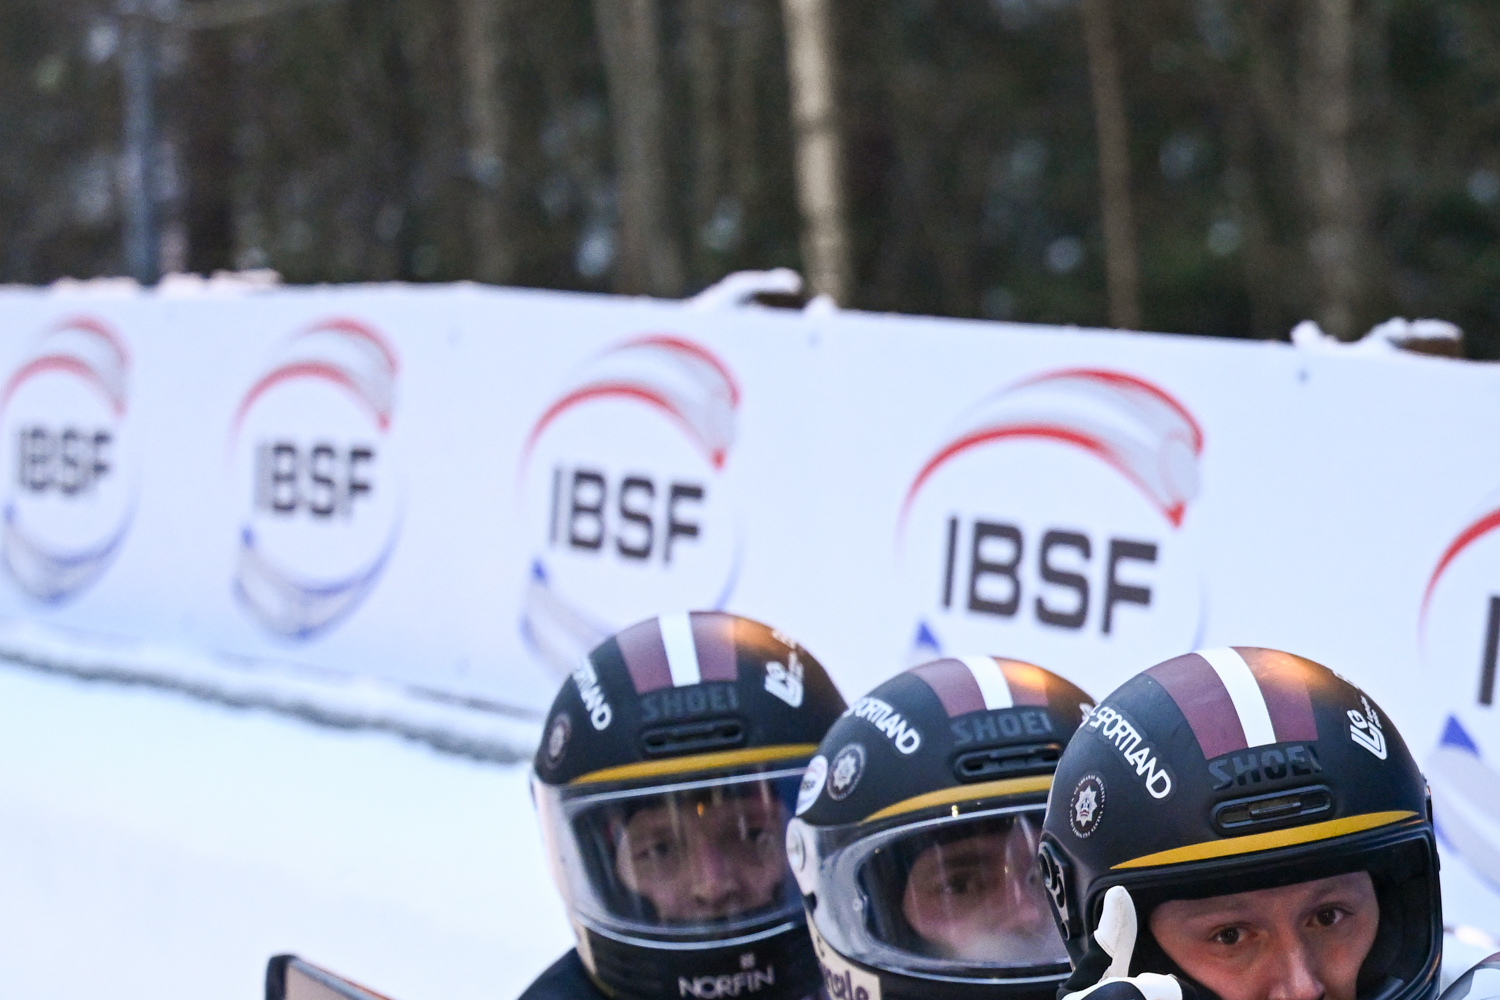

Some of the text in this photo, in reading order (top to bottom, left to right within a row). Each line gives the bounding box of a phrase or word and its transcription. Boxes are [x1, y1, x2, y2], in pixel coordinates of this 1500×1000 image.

[17, 427, 113, 497] IBSF
[254, 442, 379, 521] IBSF
[549, 465, 707, 566] IBSF
[940, 516, 1158, 636] IBSF
[952, 711, 1051, 746] SHOEI
[1089, 706, 1172, 799] SPORTLAND
[1207, 744, 1322, 792] SHOEI
[678, 965, 775, 999] NORFIN
